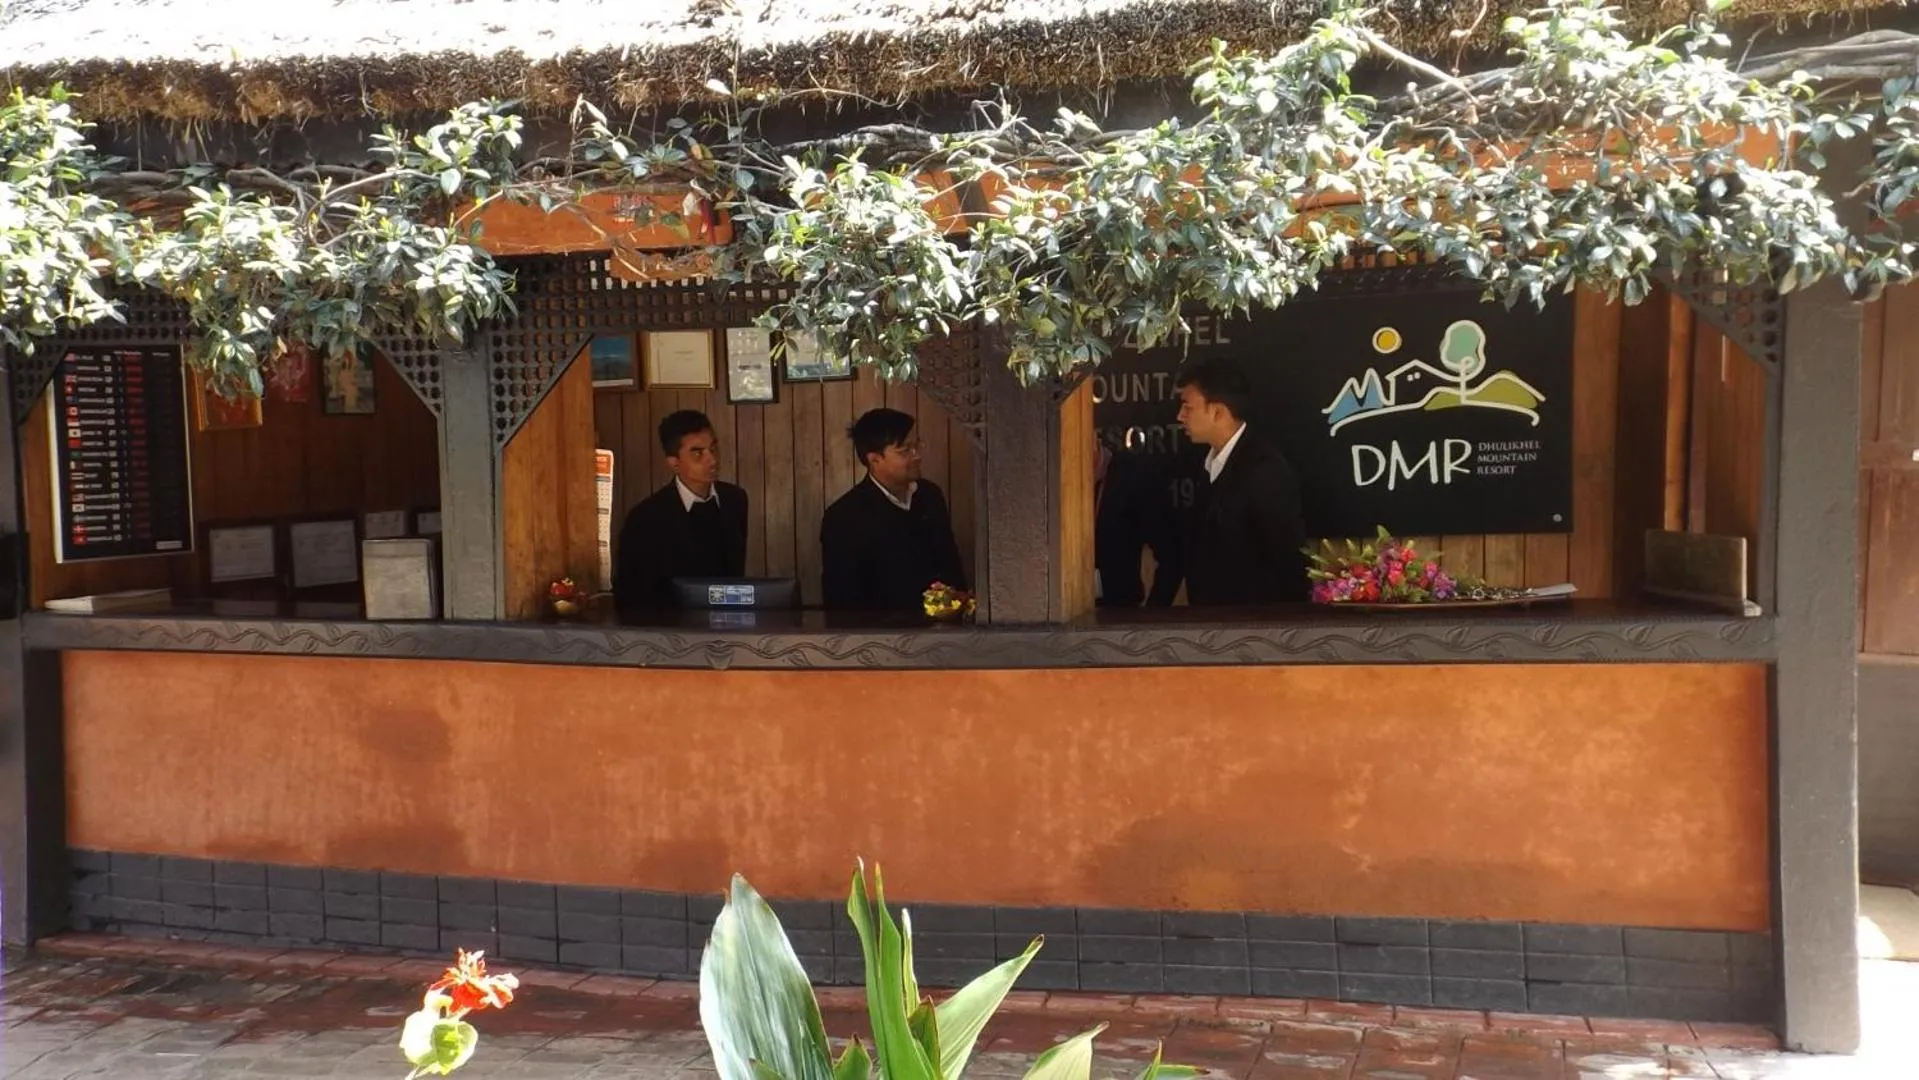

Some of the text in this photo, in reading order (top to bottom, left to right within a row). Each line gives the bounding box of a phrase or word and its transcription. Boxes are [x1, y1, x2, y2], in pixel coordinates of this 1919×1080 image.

[1478, 440, 1541, 451] DHULIKHEL
[1477, 452, 1537, 463] MOUNTAIN
[1351, 438, 1472, 491] DMR
[1477, 465, 1517, 475] RESORT
